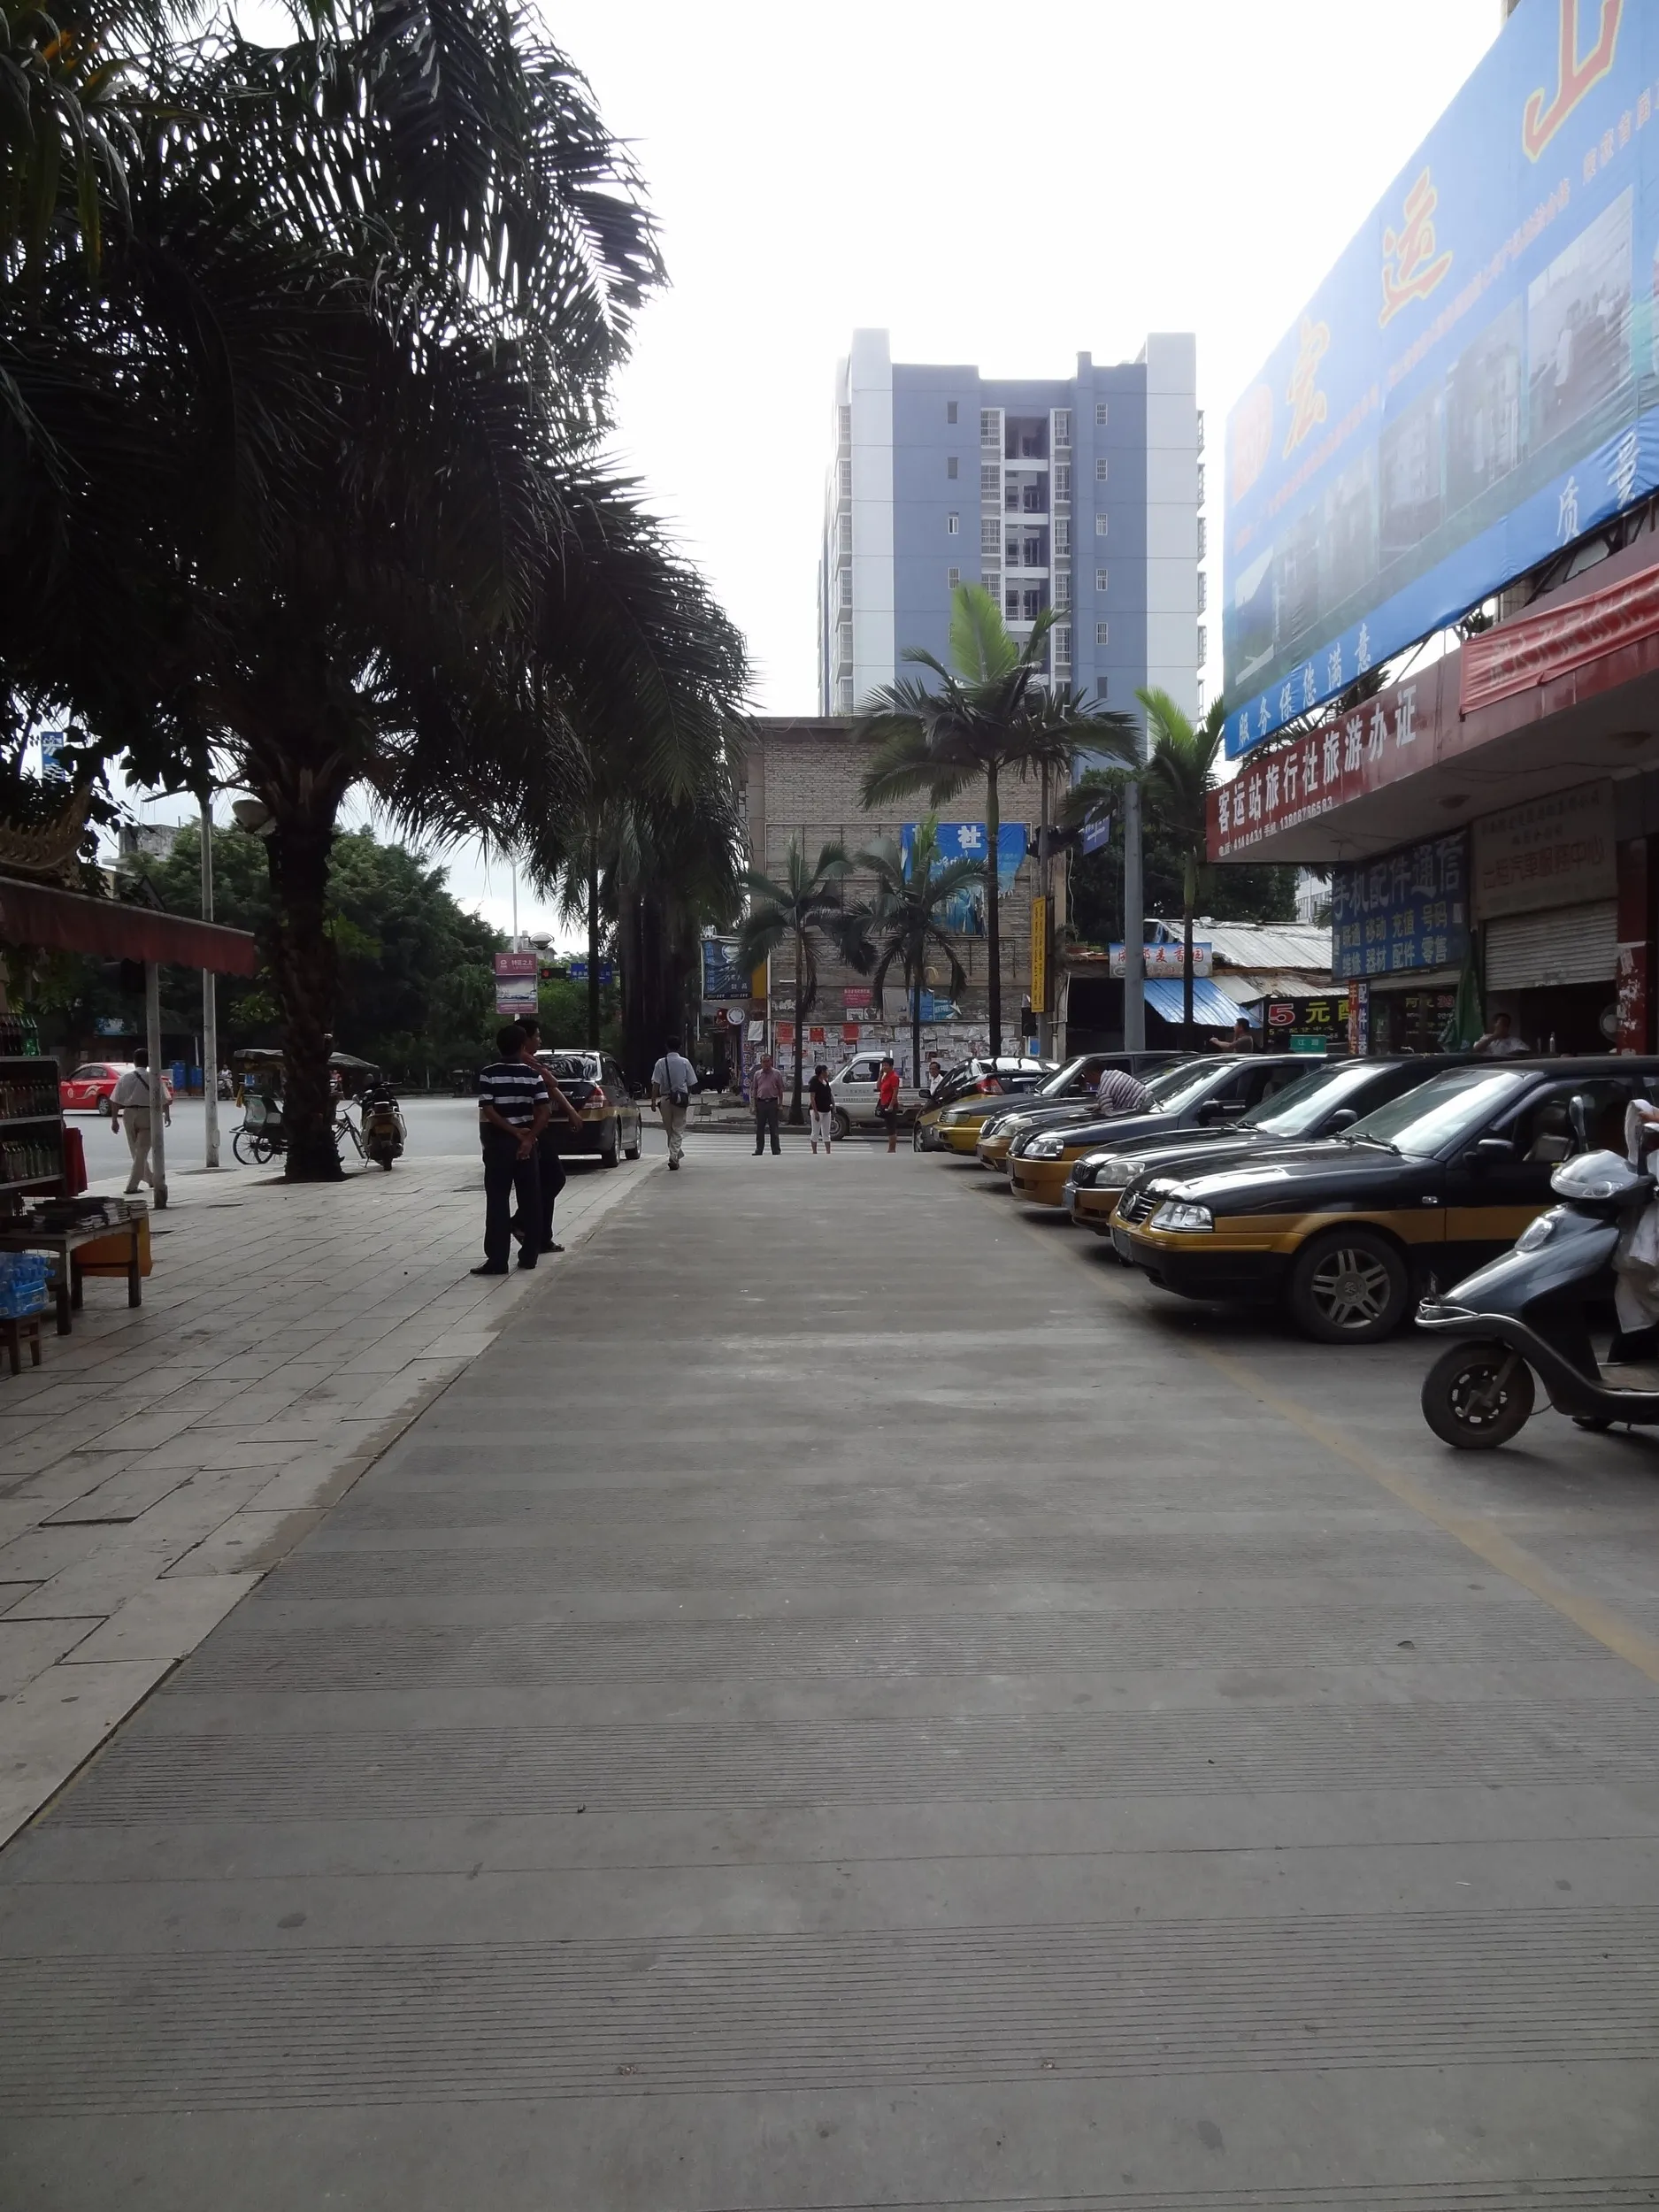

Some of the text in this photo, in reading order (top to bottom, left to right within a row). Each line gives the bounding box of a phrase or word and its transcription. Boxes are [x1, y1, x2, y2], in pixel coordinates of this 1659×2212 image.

[1557, 432, 1640, 546] 质量
[1239, 622, 1371, 745] 服务保您满意
[1218, 686, 1417, 833] 客运站旅行社旅游办证
[957, 825, 981, 849] 社
[1333, 830, 1466, 921] 手机配件通信
[1392, 910, 1415, 938] 充值
[1421, 901, 1448, 931] 号码
[1392, 941, 1415, 970] 配件
[1422, 935, 1448, 964] 零售
